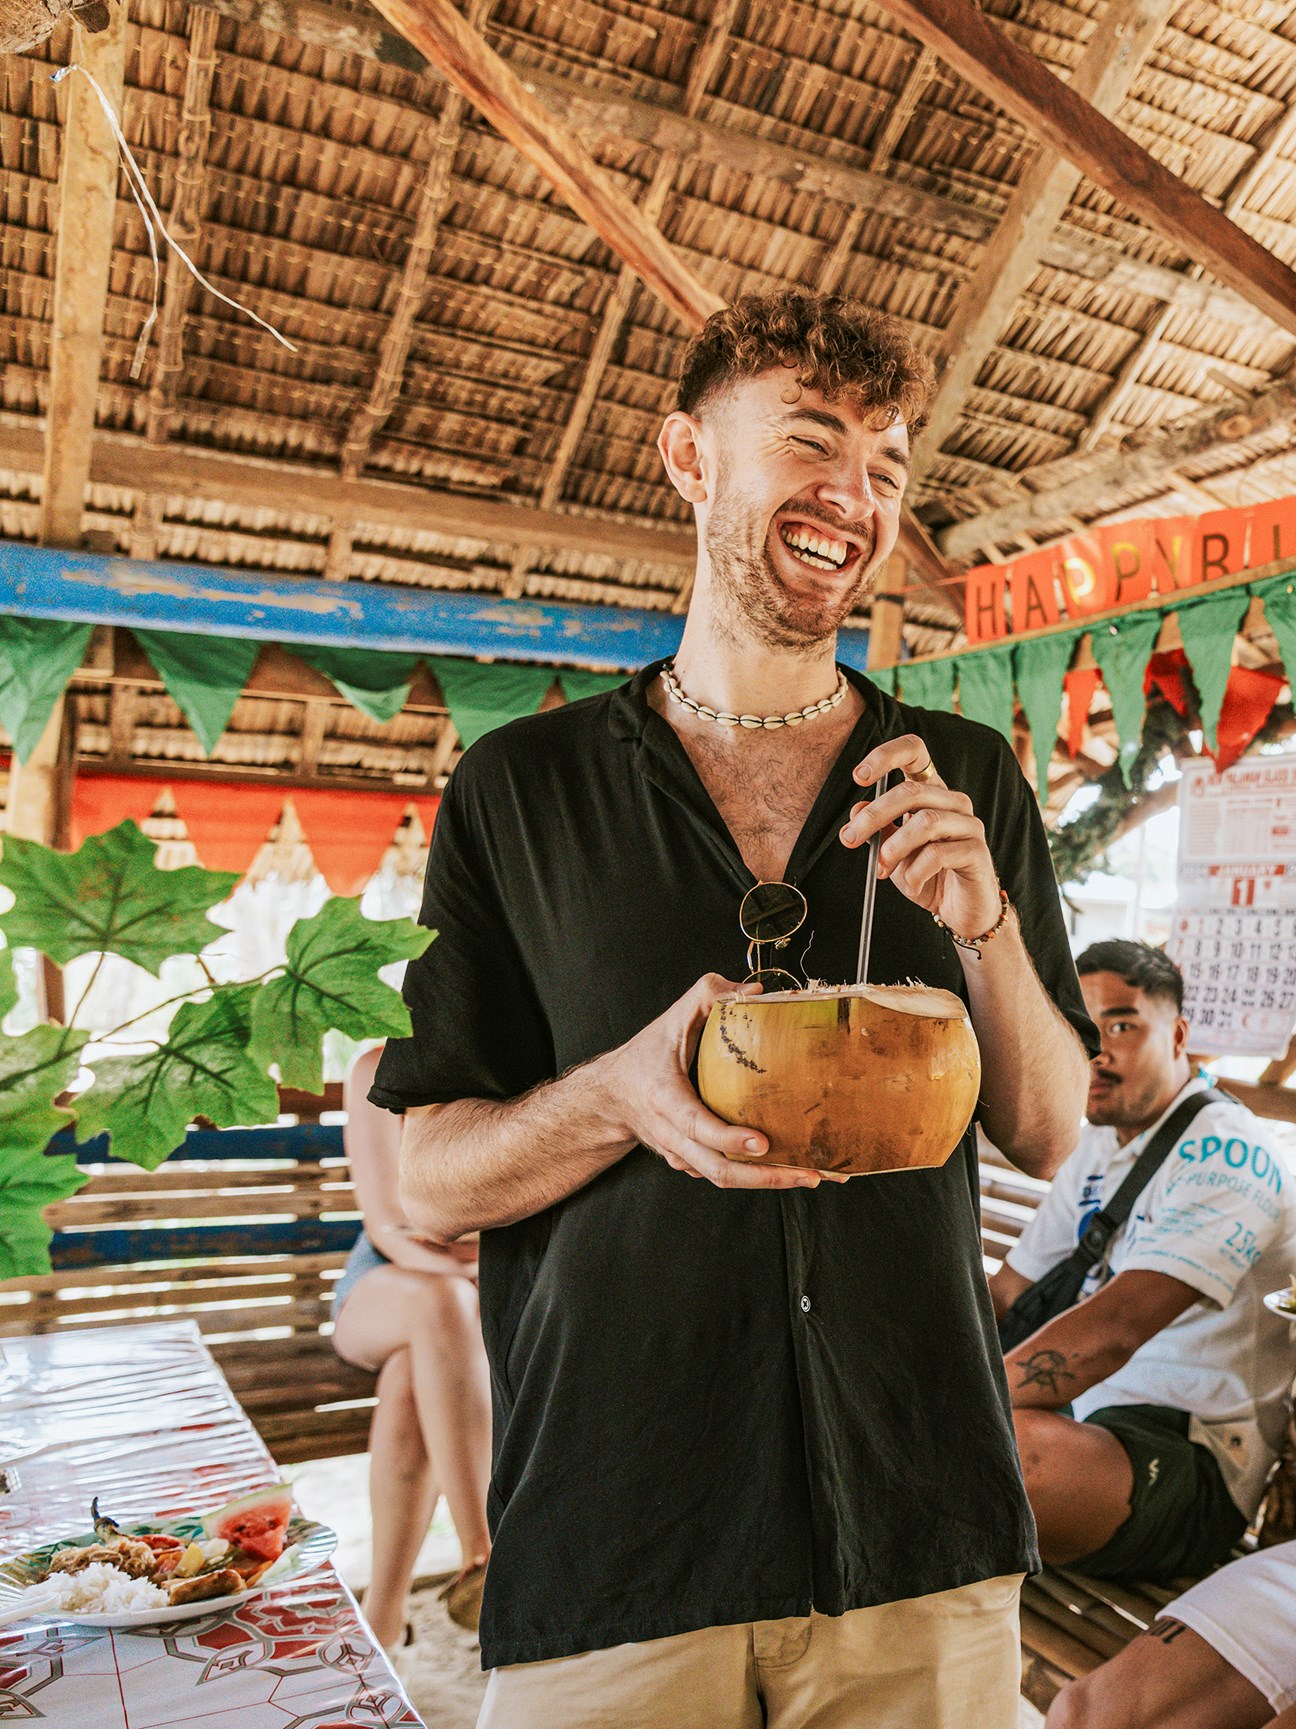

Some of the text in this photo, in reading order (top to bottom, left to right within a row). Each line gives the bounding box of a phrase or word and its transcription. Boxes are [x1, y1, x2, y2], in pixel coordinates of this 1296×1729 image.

[975, 536, 1184, 638] HAPPY
[1234, 918, 1243, 937] 3
[1231, 942, 1243, 959] 10
[1250, 943, 1262, 960] 11
[1269, 943, 1282, 961] 12
[1190, 961, 1201, 979] 15
[1209, 963, 1221, 980] 16
[1227, 964, 1239, 981] 17
[1247, 965, 1260, 983] 18
[1266, 966, 1279, 984] 19
[1202, 986, 1218, 1004] 23
[1221, 987, 1237, 1005] 24
[1260, 990, 1275, 1008] 26
[1278, 992, 1295, 1009] 27
[1179, 1135, 1282, 1195] SPOON
